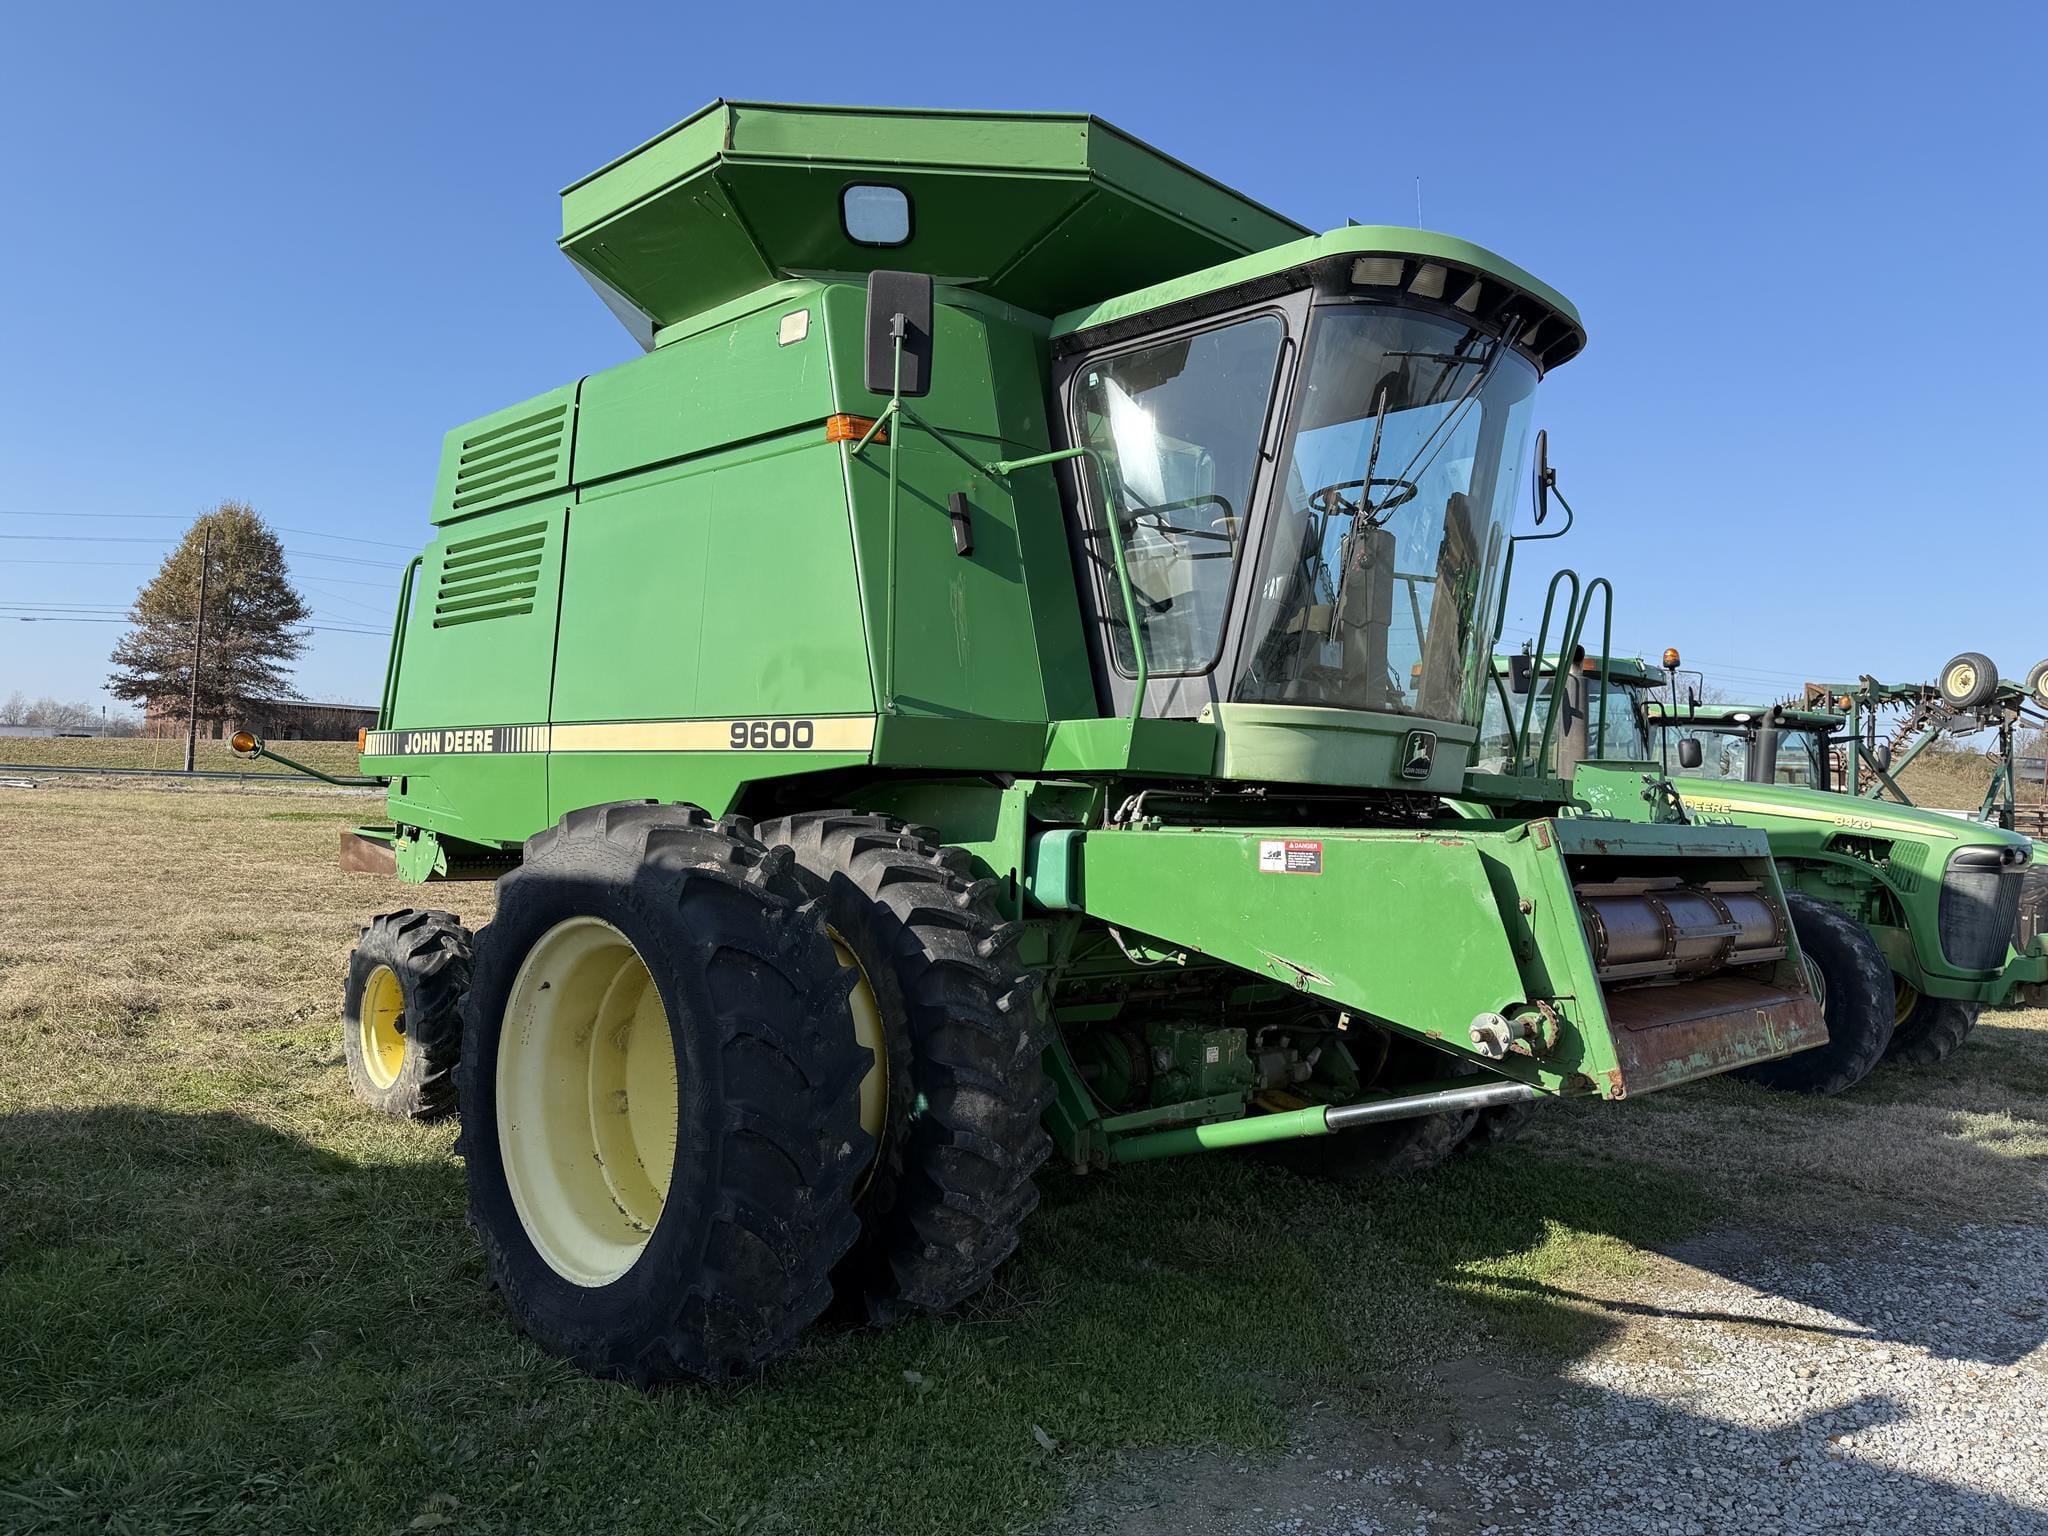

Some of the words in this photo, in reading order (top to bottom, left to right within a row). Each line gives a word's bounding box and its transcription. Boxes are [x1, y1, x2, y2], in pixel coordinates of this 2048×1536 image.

[404, 731, 441, 754] JOHN
[444, 729, 494, 753] DEERE
[730, 720, 814, 749] 9600
[1834, 815, 1873, 831] 8420
